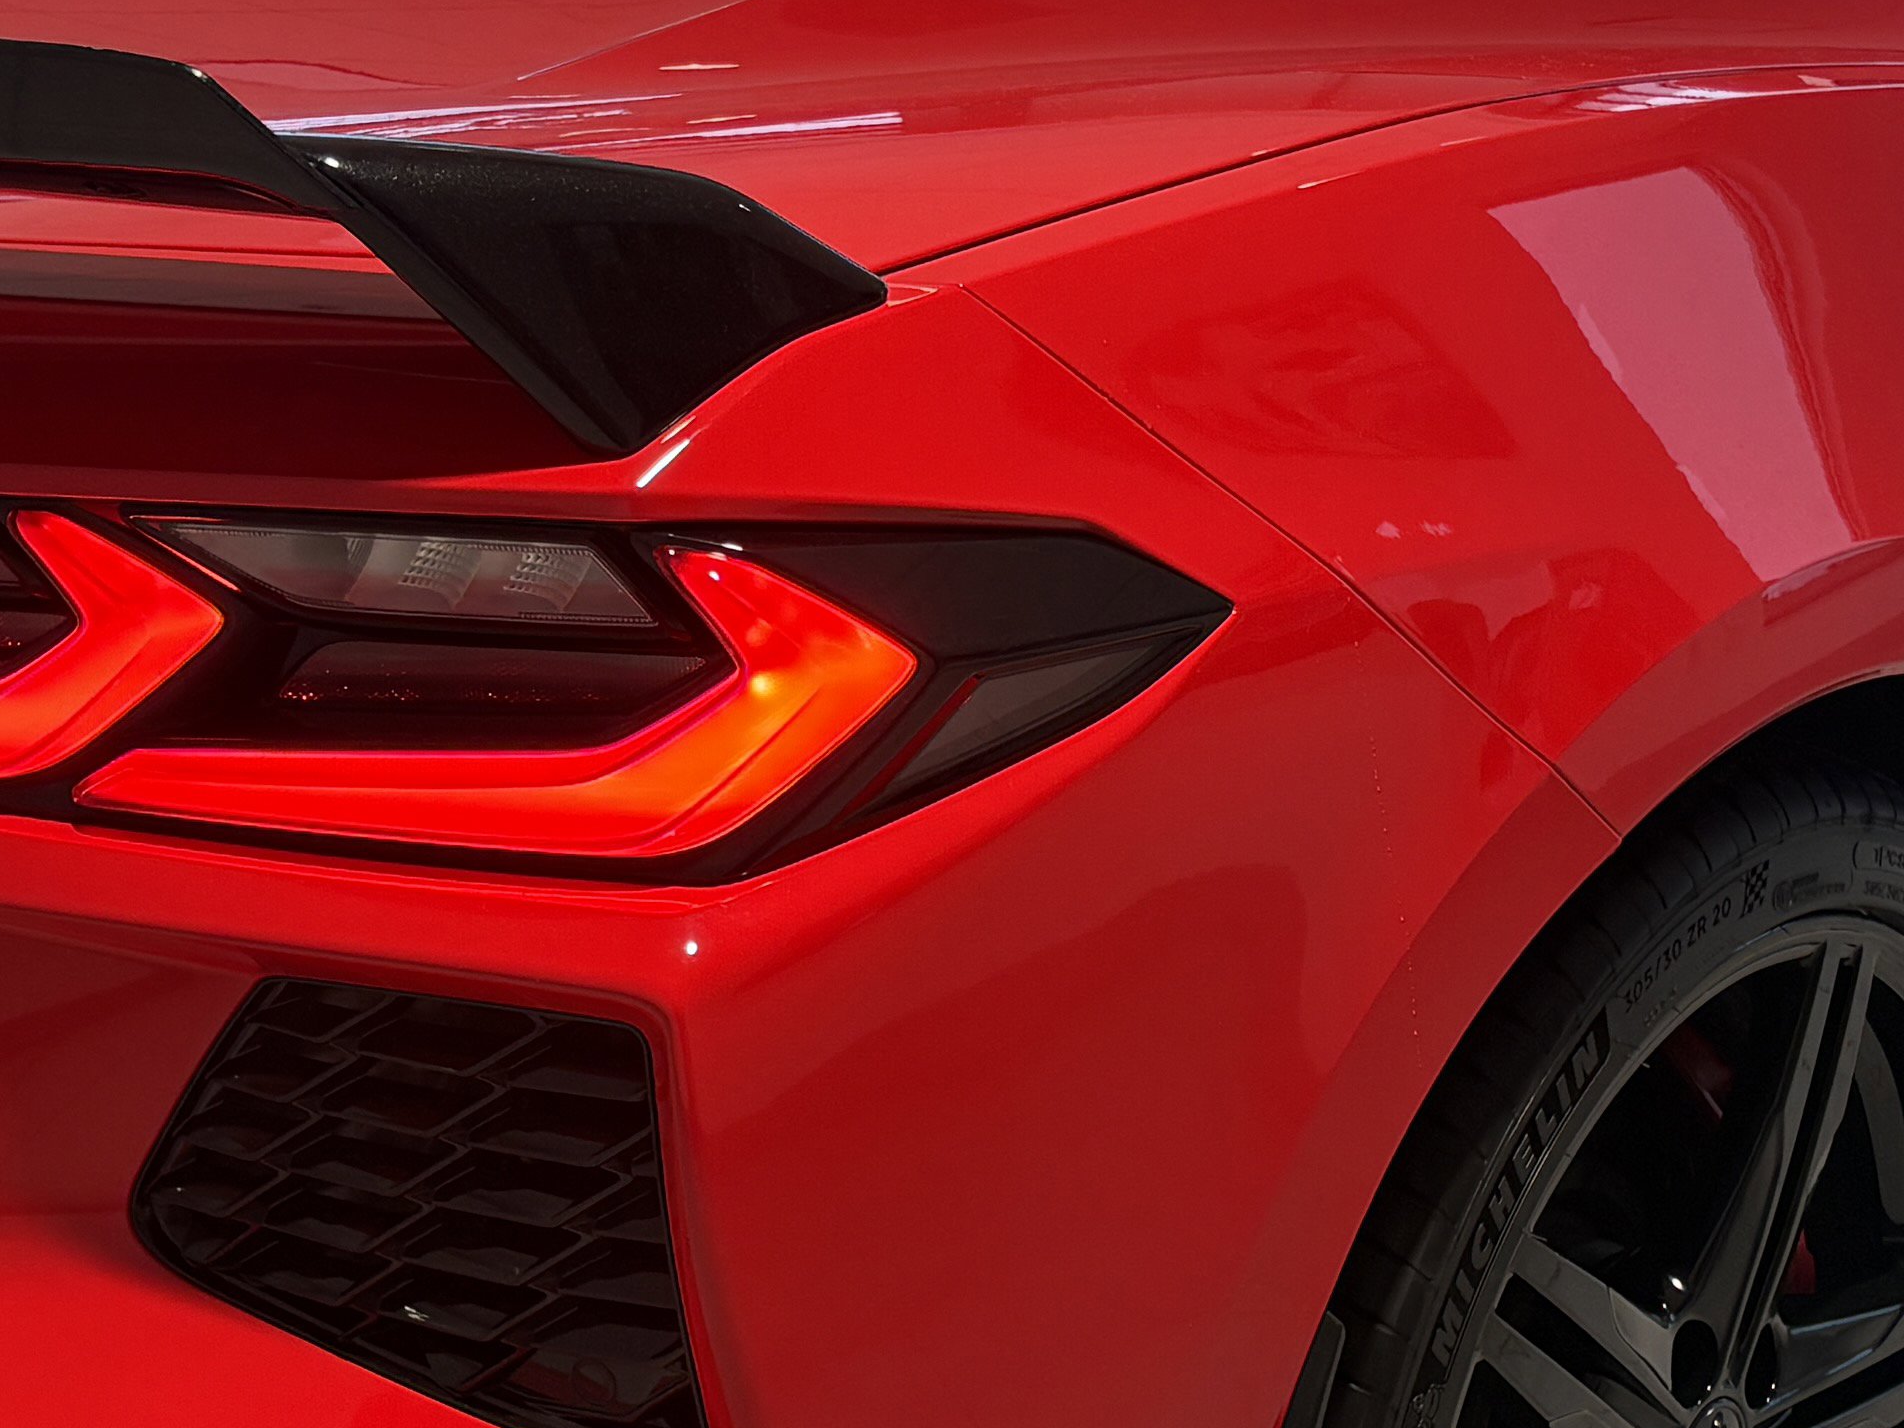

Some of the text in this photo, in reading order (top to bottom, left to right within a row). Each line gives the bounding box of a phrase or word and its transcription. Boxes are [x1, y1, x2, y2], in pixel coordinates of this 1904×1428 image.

[1625, 938, 1682, 1014] 305/30
[1687, 915, 1707, 948] ZR
[1712, 896, 1732, 926] 20
[1430, 1029, 1599, 1370] MICHELIN
